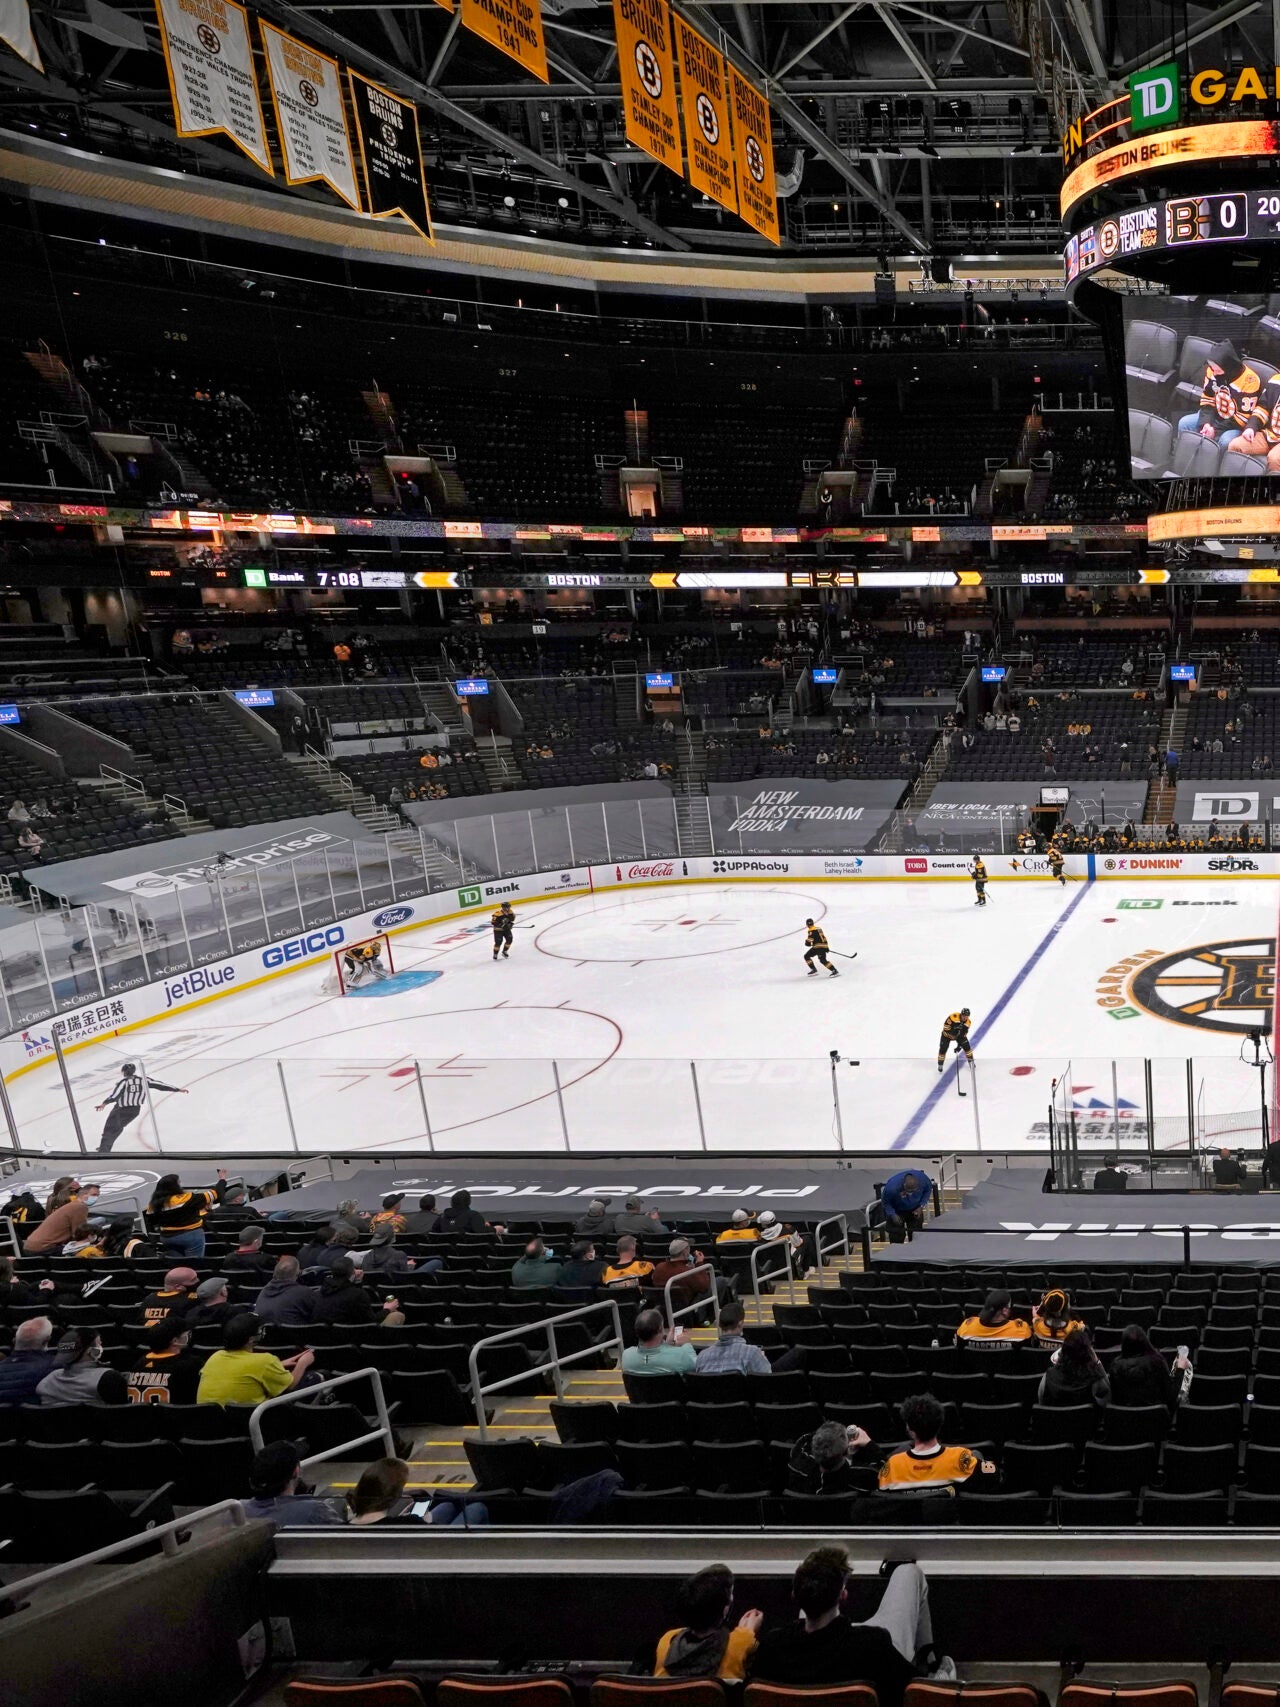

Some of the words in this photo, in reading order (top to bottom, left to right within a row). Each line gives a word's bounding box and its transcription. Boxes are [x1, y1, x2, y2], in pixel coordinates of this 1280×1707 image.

[517, 1, 534, 24] CUP
[621, 0, 666, 52] BRUINS
[498, 24, 521, 56] 1941
[680, 23, 720, 73] BOSTON
[683, 49, 722, 101] BRUINS
[367, 85, 402, 117] BOSTON
[734, 75, 766, 117] BOSTON
[1133, 77, 1173, 118] TD
[369, 101, 404, 130] BRUINS
[631, 87, 661, 123] STANLEY
[662, 110, 674, 129] CUP
[633, 110, 676, 150] CHAMPIONS
[736, 97, 768, 145] BRUINS
[380, 151, 406, 170] TROPHY
[694, 137, 717, 166] STANLEY
[718, 155, 729, 171] CUP
[694, 156, 731, 190] CHAMPIONS
[744, 191, 775, 225] CHAMPIONS
[763, 191, 773, 209] CUP
[1119, 206, 1158, 235] BOSTON'S
[1219, 200, 1237, 229] 0
[1120, 232, 1142, 253] TEAM
[246, 571, 263, 585] TD
[269, 572, 304, 583] Bank
[317, 572, 360, 587] 7:08
[547, 573, 601, 587] BOSTON
[1021, 572, 1064, 584] BOSTON
[752, 791, 799, 806] NEW
[929, 803, 958, 811] IBEW
[958, 803, 993, 811] LOCAL
[1206, 798, 1252, 815] TD
[738, 805, 865, 822] AMSTERDAM
[727, 819, 788, 832] VODKA
[628, 862, 676, 879] Coca-Cola
[726, 860, 790, 874] UPPAbaby
[824, 867, 842, 876] Lahey
[842, 867, 863, 875] Health
[838, 860, 854, 868] Israel
[1130, 859, 1184, 870] DUNKIN'
[460, 889, 481, 907] TD
[485, 881, 521, 898] Bank
[374, 909, 409, 926] Ford
[262, 926, 345, 969] GEICO
[163, 961, 188, 976] CROSS
[1096, 949, 1166, 1008] GARDEN
[118, 976, 145, 991] CROSS
[163, 965, 236, 1008] jetBlue
[75, 1015, 128, 1042] PACKAGING
[364, 1184, 821, 1199] PROSHOP
[144, 1308, 171, 1319] NEELY
